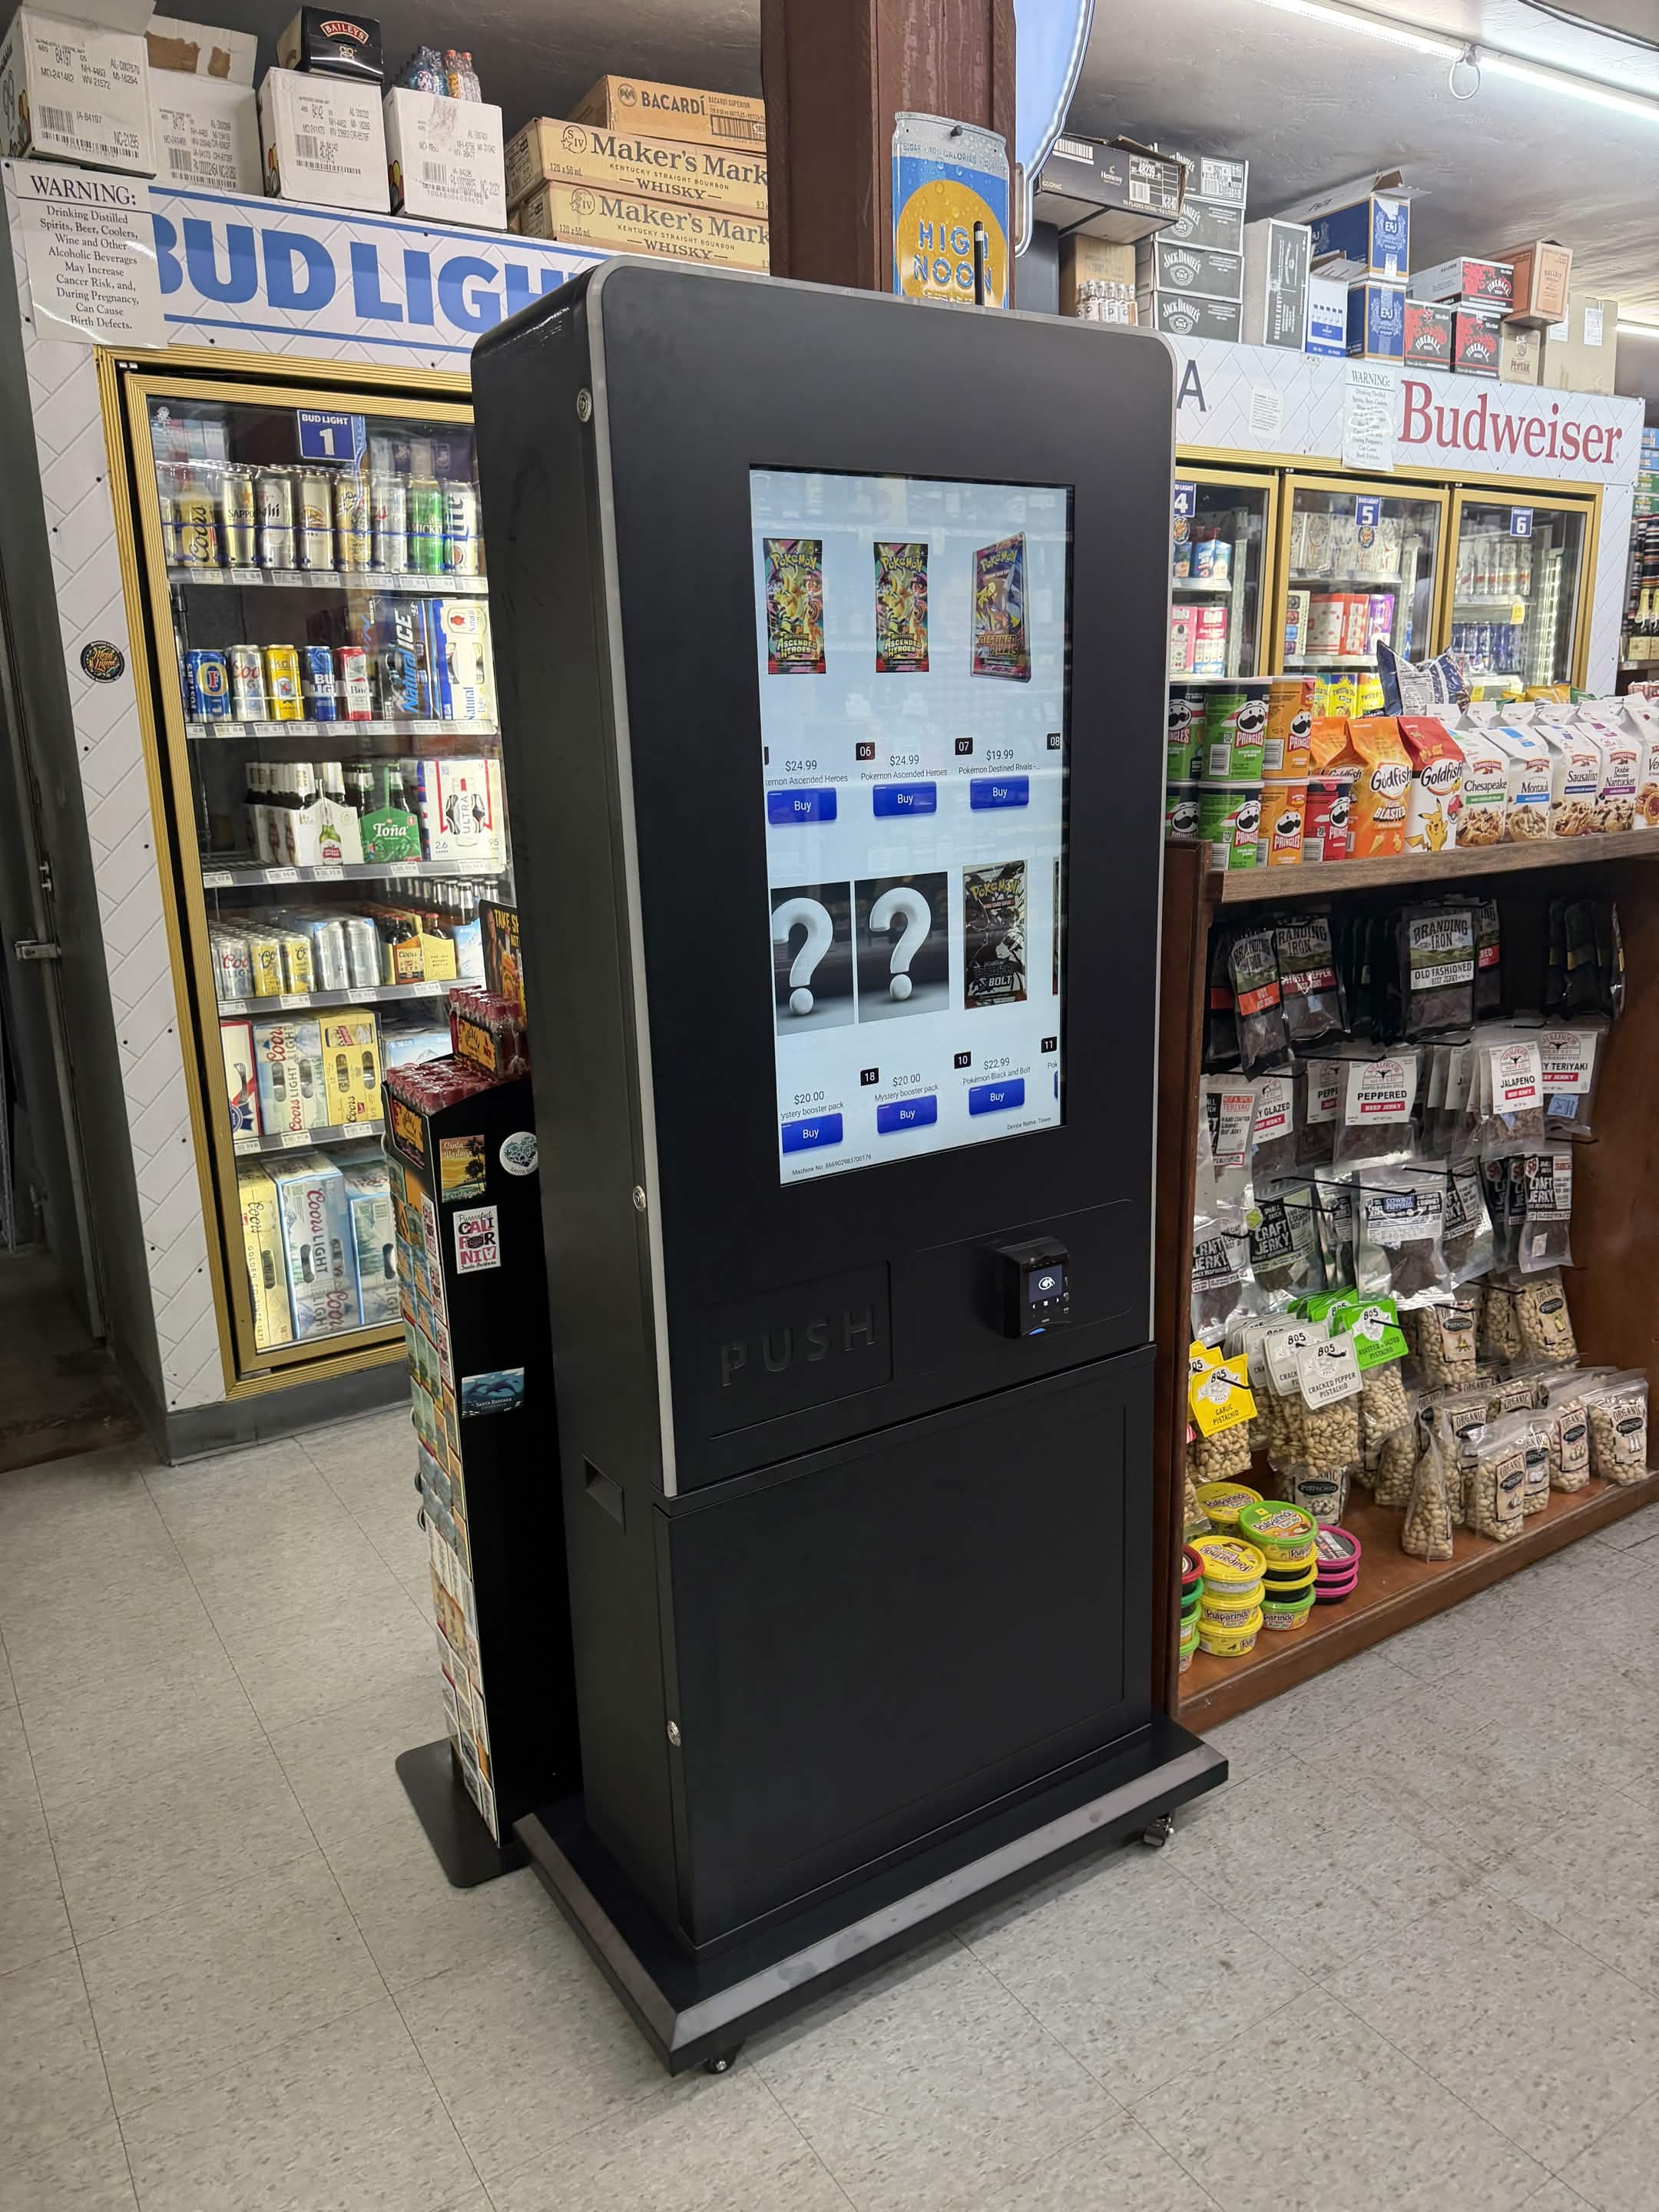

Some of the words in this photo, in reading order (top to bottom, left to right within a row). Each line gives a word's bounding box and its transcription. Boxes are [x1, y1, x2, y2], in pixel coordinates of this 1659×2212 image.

[324, 23, 365, 39] BAILEYS
[641, 91, 705, 115] BACARDÍ
[591, 132, 697, 172] Maker's
[703, 154, 767, 186] Mark
[610, 164, 650, 176] KENTUCKY
[654, 171, 690, 184] STRAIGHT
[694, 179, 730, 190] BOURBON
[31, 175, 136, 205] WARNING:
[636, 178, 706, 200] WHISKY
[47, 206, 88, 221] Drinking
[91, 210, 128, 224] Distilled
[599, 196, 703, 233] Maker's
[708, 217, 769, 245] Mark
[39, 218, 72, 233] Spirits,
[75, 222, 99, 235] Beer,
[101, 226, 138, 239] Coolers,
[55, 233, 79, 246] Wine
[82, 238, 98, 247] and
[101, 239, 127, 250] Other
[618, 224, 657, 237] KENTUCKY
[661, 232, 697, 245] STRAIGHT
[701, 239, 735, 250] BOURBON
[48, 247, 91, 260] Alcoholic
[94, 251, 137, 265] Beverages
[644, 239, 713, 260] WHISKY
[65, 261, 84, 274] May
[88, 263, 124, 276] Increase
[1179, 249, 1201, 274] DANIEL'S
[151, 212, 336, 311] BUD
[350, 241, 578, 333] LIGH
[56, 274, 88, 286] Cancer
[91, 277, 115, 290] Risk,
[117, 280, 136, 292] and,
[56, 286, 89, 301] During
[91, 290, 139, 305] Pregnancy,
[75, 303, 94, 313] Can
[97, 305, 124, 316] Cause
[1179, 298, 1200, 326] DANIEL'S
[70, 315, 94, 326] Birth
[97, 317, 132, 329] Defects.
[1177, 359, 1207, 412] A
[1352, 370, 1390, 388] WARNING:
[301, 413, 321, 424] BUD
[323, 416, 349, 427] LIGHT
[1398, 379, 1623, 464] Budweiser
[319, 427, 336, 455] 1
[1174, 492, 1188, 514] 4
[1362, 505, 1373, 524] 5
[1516, 515, 1527, 535] 6
[189, 505, 210, 563] Coors
[395, 608, 415, 650] ICE
[777, 638, 818, 651] ASCENDED
[780, 646, 814, 658] HEROES
[885, 638, 922, 651] ASCENDED
[207, 671, 220, 689] F
[399, 647, 419, 714] Natural
[959, 741, 969, 751] 07
[1050, 736, 1060, 747] 08
[1236, 730, 1263, 747] PRINGLES
[859, 746, 872, 757] 06
[986, 749, 1014, 761] $19.99
[785, 760, 817, 772] $24.99
[889, 755, 920, 767] $24.99
[988, 763, 1015, 773] Destined
[1015, 762, 1032, 771] Rivals
[790, 774, 823, 785] Ascended
[825, 773, 849, 783] Heroes
[893, 769, 925, 779] Ascended
[926, 768, 949, 777] Heroes
[1421, 760, 1463, 787] Goldfish
[1568, 769, 1598, 783] Sausalito
[1464, 778, 1507, 793] Chesapeake
[1522, 781, 1549, 793] Montauk
[1605, 776, 1635, 787] Nantucket
[897, 793, 914, 806] Buy
[992, 786, 1008, 799] Buy
[794, 800, 811, 813] Buy
[1373, 806, 1406, 820] BLASTED
[462, 795, 471, 834] ULTRA
[373, 823, 407, 837] Toña
[435, 841, 449, 849] 2.6
[1273, 836, 1300, 850] PRINGLES
[494, 909, 510, 929] TAKE
[1414, 919, 1468, 946] BRANDING
[1288, 939, 1311, 955] IRON
[1431, 932, 1453, 950] IRON
[1414, 969, 1429, 980] OLD
[1432, 962, 1472, 978] FASHIONED
[988, 975, 1012, 987] BOLT
[267, 1026, 286, 1063] Coors
[1044, 1039, 1054, 1051] 11
[958, 1055, 968, 1065] 10
[983, 1057, 1010, 1070] $22.99
[1551, 1062, 1588, 1071] TERIYAKI
[864, 1071, 876, 1082] 18
[892, 1073, 921, 1088] $20.00
[991, 1071, 1007, 1081] Black
[1019, 1066, 1031, 1075] Bolt
[287, 1068, 300, 1098] LIGHT
[1500, 1075, 1535, 1088] JALAPENO
[794, 1091, 825, 1105] $20.00
[875, 1091, 899, 1103] Mystery
[899, 1087, 923, 1099] booster
[924, 1084, 939, 1094] pack
[990, 1092, 1005, 1102] Buy
[1357, 1091, 1407, 1101] PEPPERED
[289, 1099, 303, 1131] Coors
[346, 1095, 356, 1123] Coors
[802, 1104, 828, 1116] booster
[828, 1101, 845, 1114] pack
[899, 1109, 916, 1121] Buy
[1264, 1102, 1290, 1116] GLAZED
[1007, 1122, 1022, 1131] Device
[1038, 1116, 1051, 1124] Tower
[802, 1128, 820, 1141] Buy
[792, 1165, 815, 1177] Machine
[1529, 1177, 1553, 1190] CRAFT
[1386, 1197, 1412, 1205] COWBOY
[1528, 1190, 1554, 1204] JERKY
[247, 1202, 264, 1234] Coors
[307, 1190, 326, 1233] Coors
[1256, 1220, 1287, 1242] CRAFT
[1258, 1231, 1290, 1255] JERKY
[312, 1234, 329, 1273] LIGHT
[1194, 1253, 1228, 1271] JERKY
[1363, 1307, 1379, 1320] 805
[720, 1305, 876, 1388] PUSH
[1288, 1333, 1306, 1345] 805
[1318, 1344, 1336, 1357] 805
[1369, 1347, 1393, 1359] PISTACHIO
[1211, 1369, 1227, 1384] 805
[1308, 1379, 1333, 1395] CRACKED
[1334, 1373, 1356, 1386] PEPPER
[1320, 1383, 1349, 1399] PISTACHIO
[1504, 1392, 1532, 1407] ORGANIC
[1213, 1410, 1240, 1426] PISTACHIO
[1215, 1405, 1233, 1416] GARLIC
[1614, 1405, 1641, 1420] ORGANIC
[1456, 1411, 1485, 1426] ORGANIC
[1300, 1484, 1337, 1494] PISTACHIO
[1200, 1546, 1253, 1572] Pulparindo
